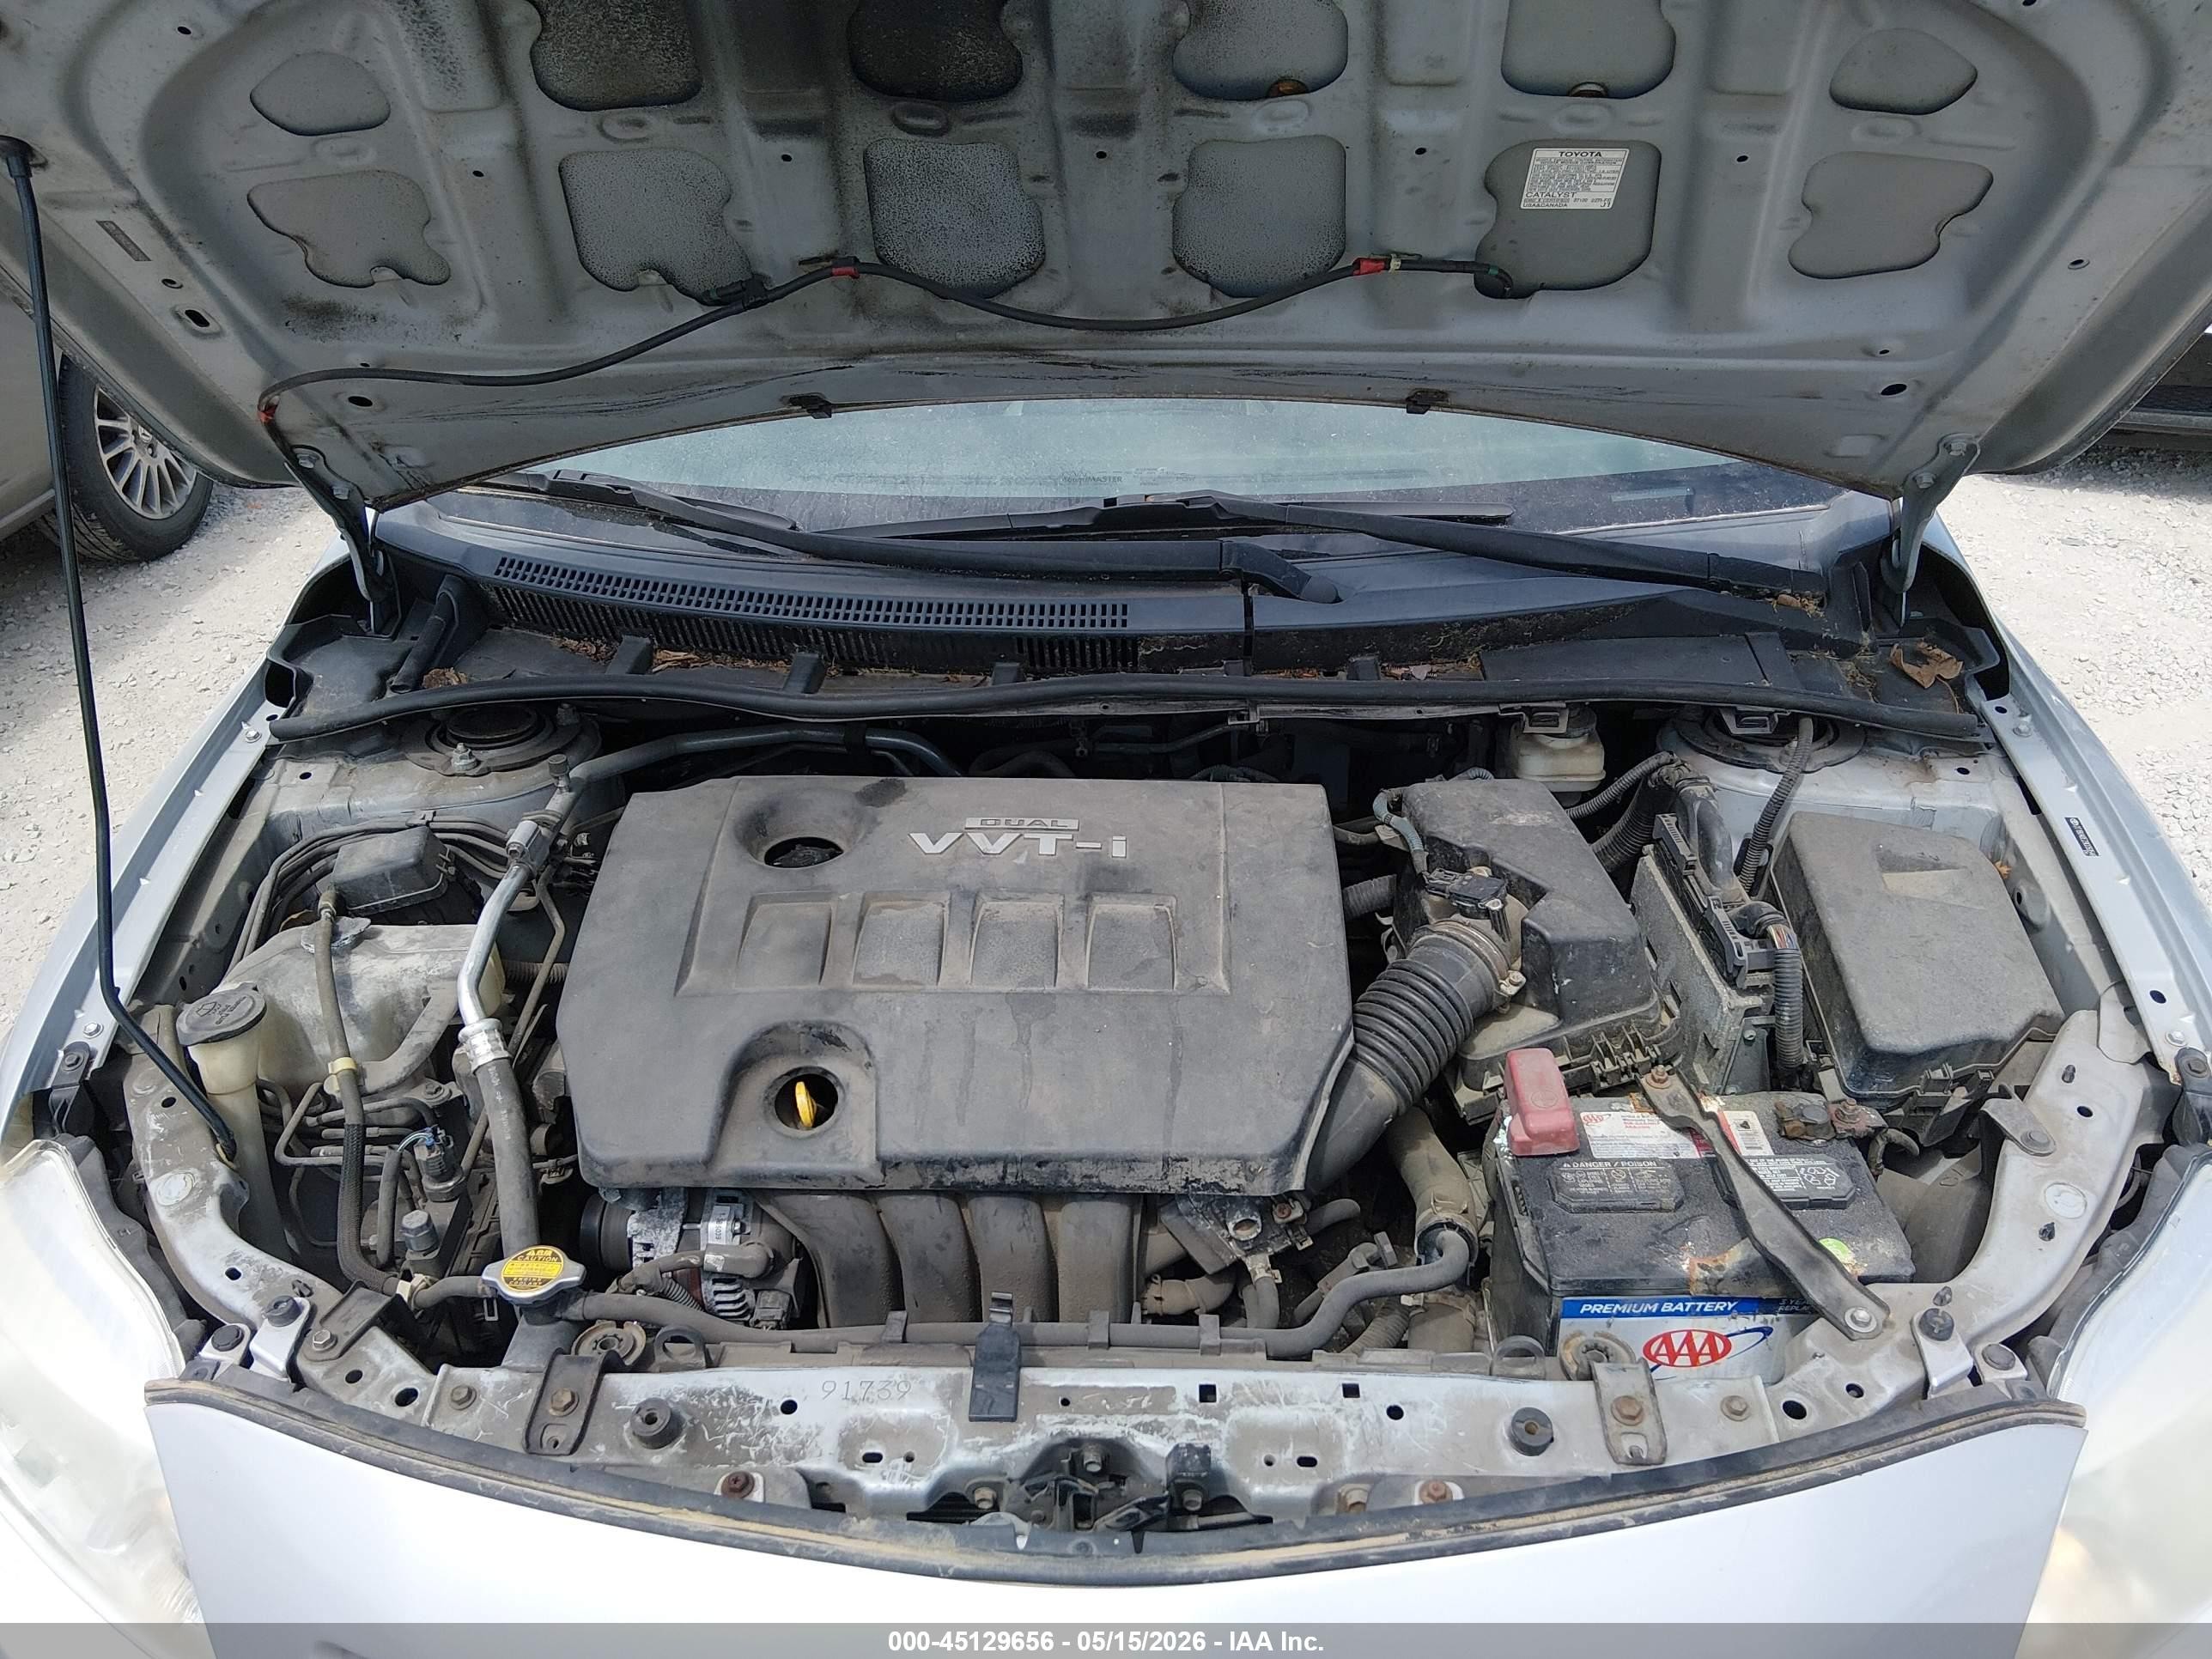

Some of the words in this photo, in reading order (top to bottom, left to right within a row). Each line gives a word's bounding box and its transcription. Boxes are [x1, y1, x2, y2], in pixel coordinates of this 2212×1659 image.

[980, 818, 1068, 828] DUAL
[908, 831, 1127, 859] VVT-i
[1580, 1302, 1658, 1314] PREMIUM
[1661, 1301, 1739, 1313] BATTERY
[1654, 1330, 1719, 1366] AAA
[821, 1380, 912, 1401] 91739
